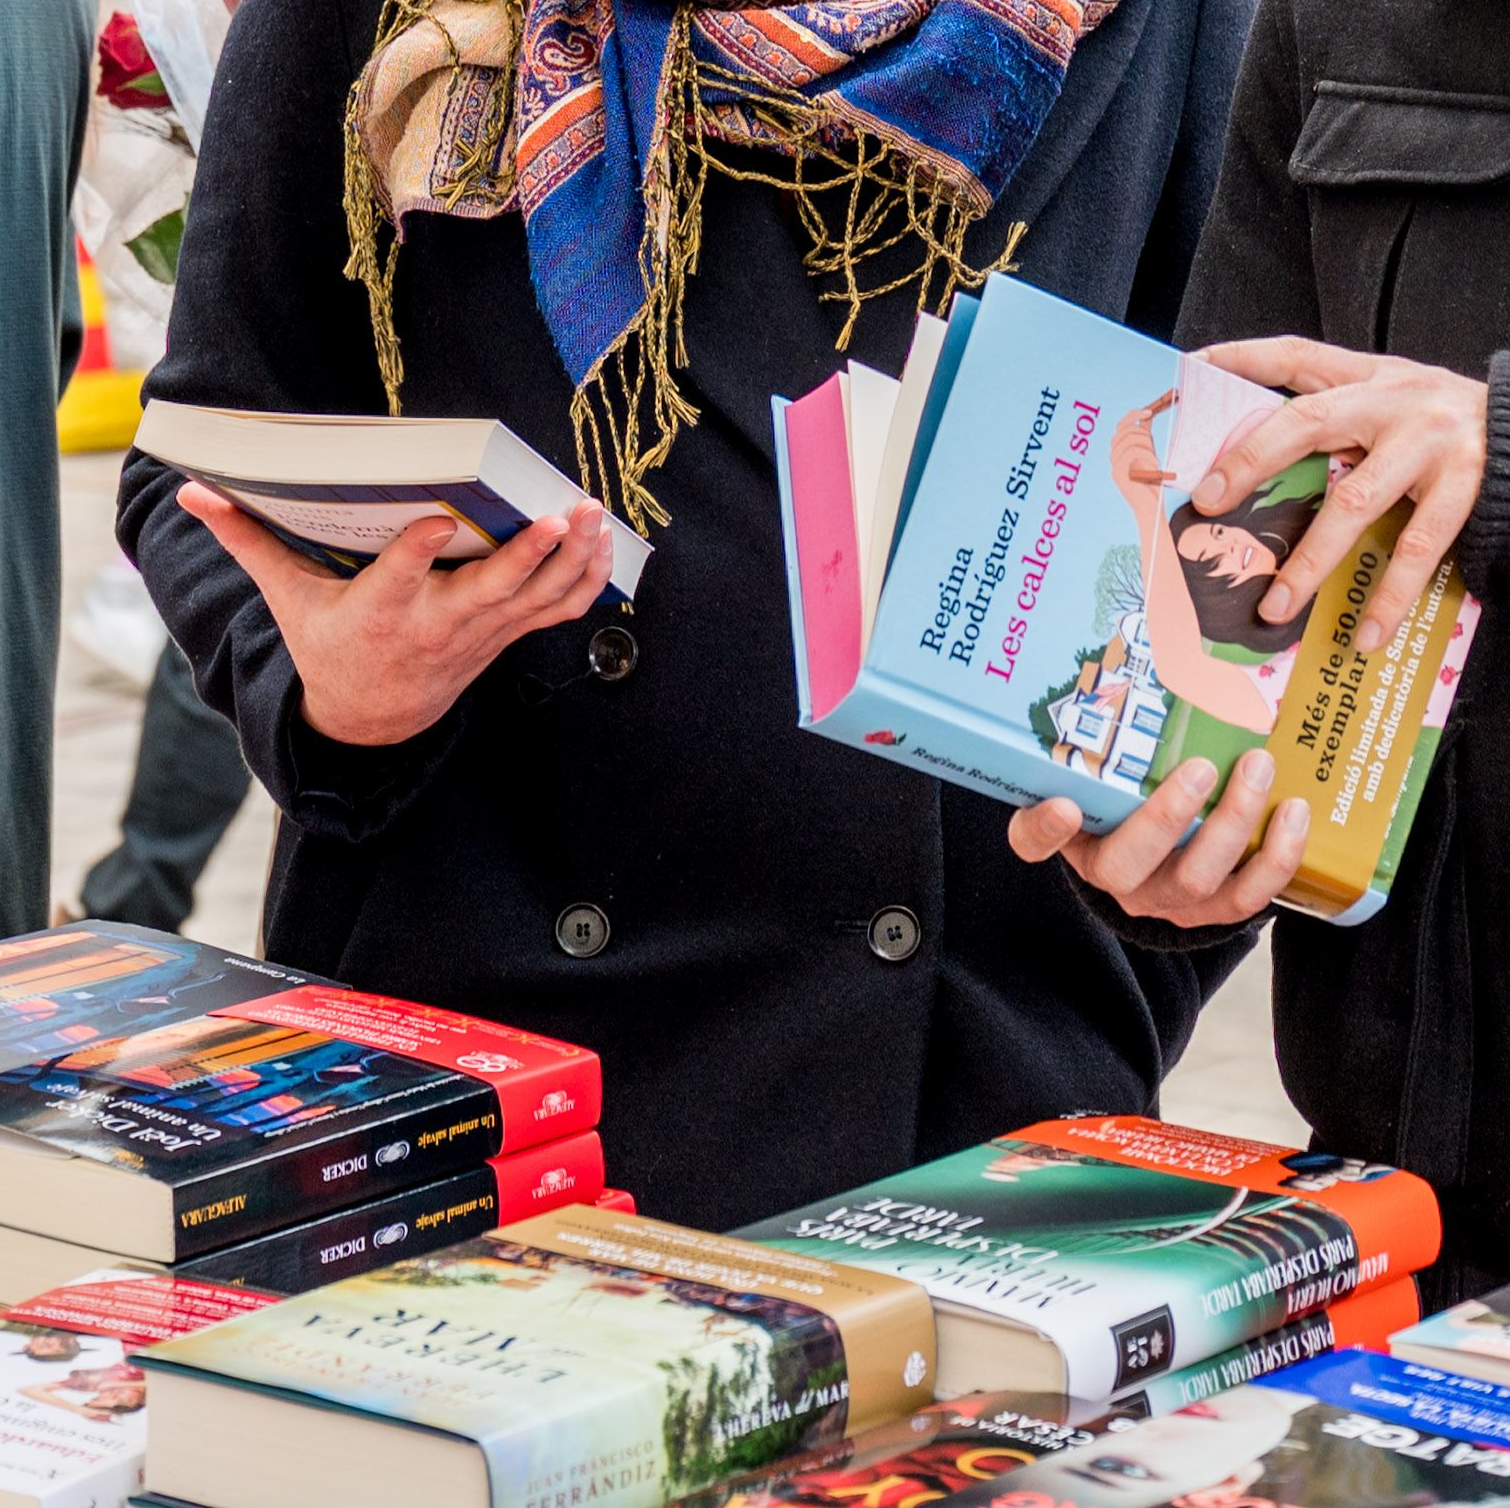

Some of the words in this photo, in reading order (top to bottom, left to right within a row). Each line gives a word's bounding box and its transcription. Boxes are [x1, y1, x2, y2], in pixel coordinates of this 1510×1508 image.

[949, 508, 1019, 667] Rodríguez
[1006, 385, 1060, 500] Sirvent
[985, 616, 1028, 683] Les
[1017, 499, 1067, 611] calces
[1054, 458, 1081, 496] al
[1069, 399, 1101, 456] sol
[920, 547, 974, 654] Regina
[1416, 559, 1454, 635] l'autora.
[1297, 691, 1331, 750] Més
[1319, 653, 1345, 687] de
[1333, 552, 1377, 648] 50.000
[1386, 619, 1412, 661] Sant
[1409, 632, 1428, 656] de
[1378, 663, 1397, 688] de
[1315, 651, 1367, 782] exemplar
[1349, 686, 1387, 768] limitada
[1374, 658, 1420, 760] dedicatòria
[911, 746, 965, 774] Regina
[1330, 765, 1362, 827] Edició
[1363, 758, 1385, 803] amb
[46, 1099, 134, 1138] Dicker
[116, 1096, 189, 1128] animal
[446, 1118, 479, 1142] animal
[481, 1114, 495, 1130] Un
[132, 1121, 201, 1153] Joël
[189, 1122, 222, 1142] Un
[417, 1129, 448, 1149] salvaje
[321, 1153, 368, 1182] DICKER
[181, 1193, 247, 1229] ALFAGUARA
[415, 1210, 447, 1229] salvaje
[444, 1199, 477, 1222] animal
[479, 1194, 494, 1210] Un
[853, 1196, 985, 1231] TARDE
[320, 1236, 366, 1264] DICKER
[788, 1219, 898, 1250] PARÍS
[826, 1205, 1058, 1264] DESPERTABA
[1319, 1234, 1355, 1272] PARÍS
[1241, 1252, 1321, 1300] DESPERTABA
[1332, 1252, 1389, 1296] MÁXIMO
[1201, 1284, 1242, 1320] TARDE
[1287, 1273, 1332, 1315] HUERTA
[304, 1314, 569, 1384] L'HEREVA
[1301, 1321, 1335, 1357] PARÍS
[1223, 1339, 1302, 1386] DESPERTABA
[1180, 1369, 1222, 1402] TARDE
[569, 1441, 654, 1478] FRANCISCO
[525, 1460, 657, 1508] ERRÁNDIZ
